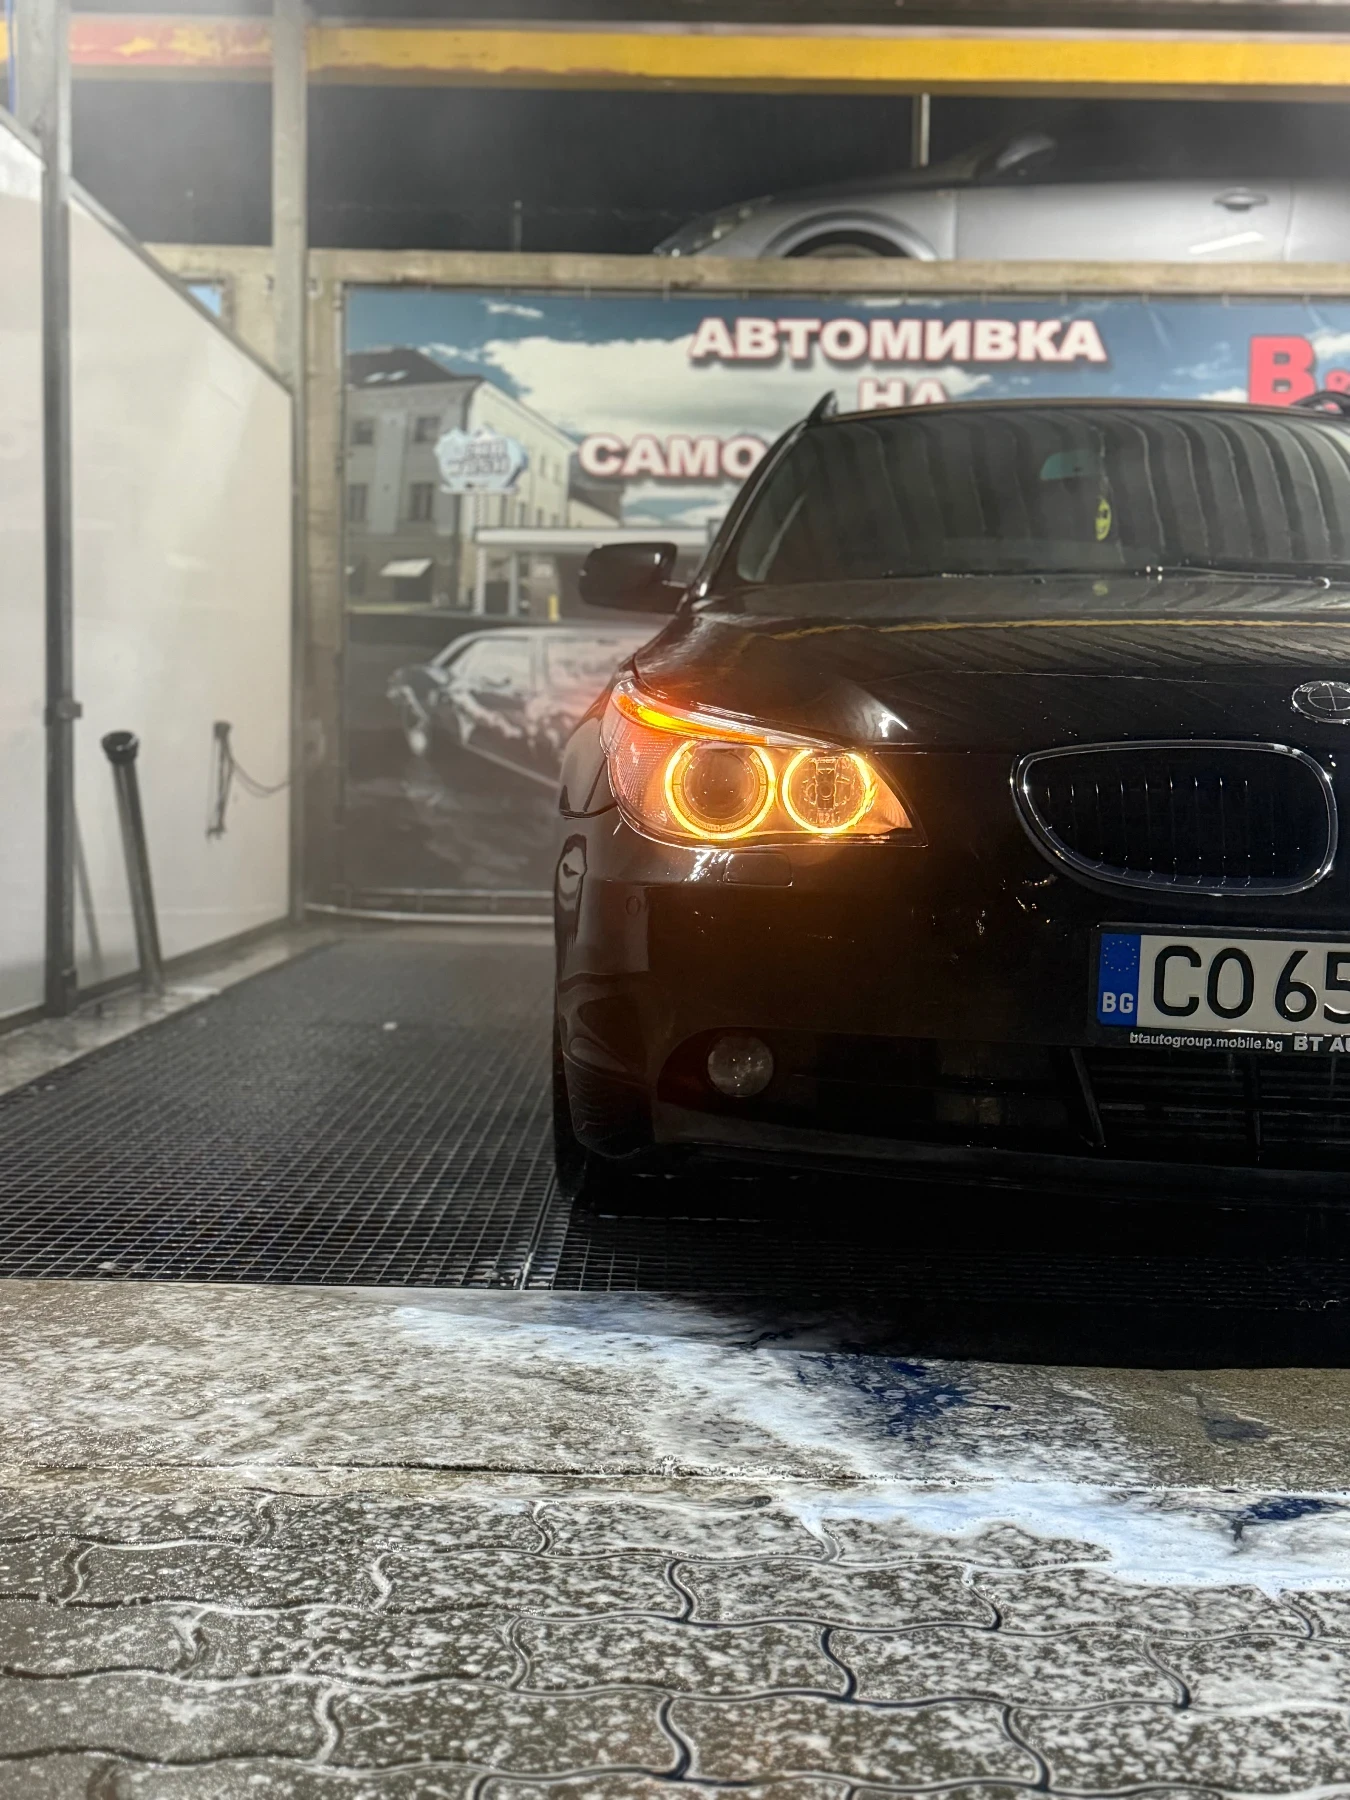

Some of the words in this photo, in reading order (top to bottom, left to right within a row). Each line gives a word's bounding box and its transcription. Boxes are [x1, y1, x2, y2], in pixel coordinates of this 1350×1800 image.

[689, 317, 1107, 362] АВТОМИВКА
[858, 377, 949, 411] НА
[1153, 944, 1255, 1020] CO
[1101, 991, 1134, 1014] BG
[1129, 1031, 1283, 1053] btautogroup.mobile.bg
[1293, 1035, 1323, 1052] BT
